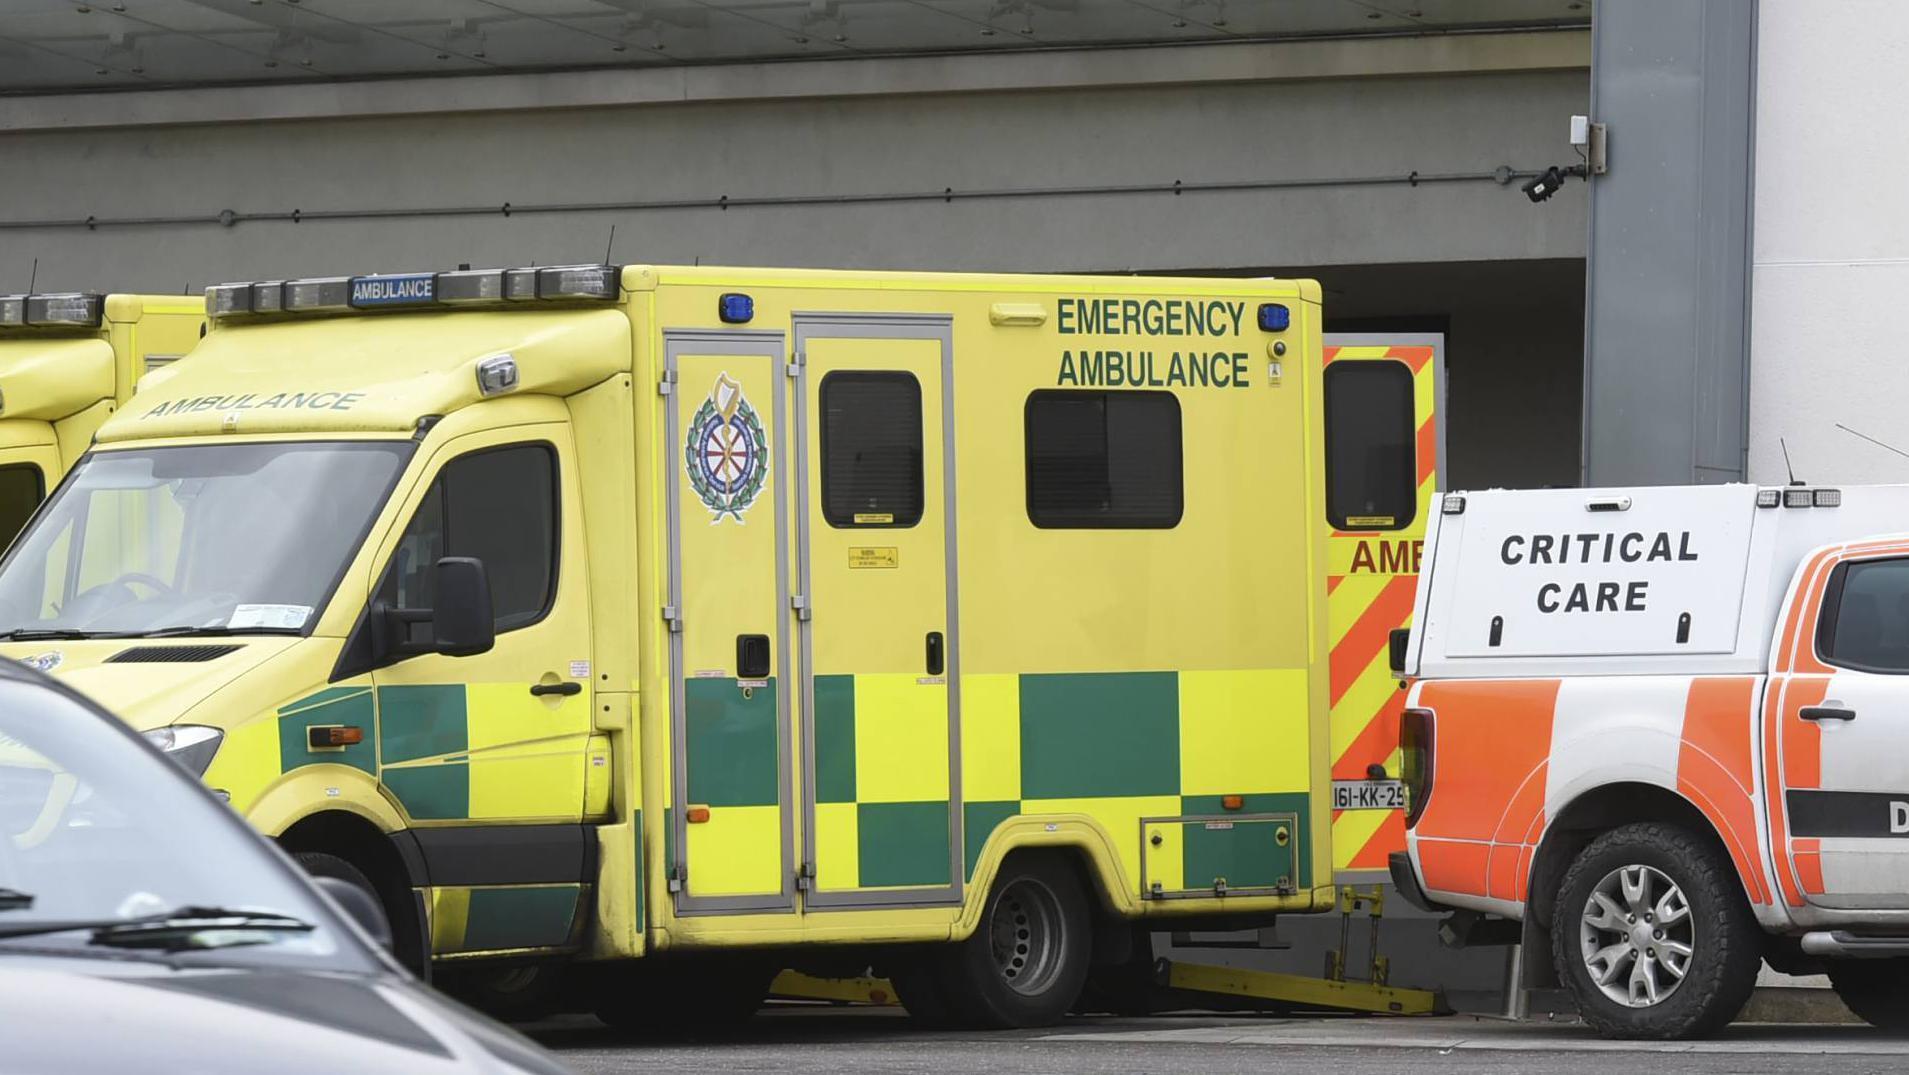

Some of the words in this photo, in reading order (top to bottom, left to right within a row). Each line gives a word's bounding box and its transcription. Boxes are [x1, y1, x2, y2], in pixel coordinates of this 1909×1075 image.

[353, 279, 433, 300] AMBULANCE
[1058, 299, 1245, 336] EMERGENCY
[1057, 350, 1249, 388] AMBULANCE
[142, 392, 367, 420] AMBULANCE
[1500, 531, 1698, 566] CRITICAL
[1537, 581, 1649, 614] CARE
